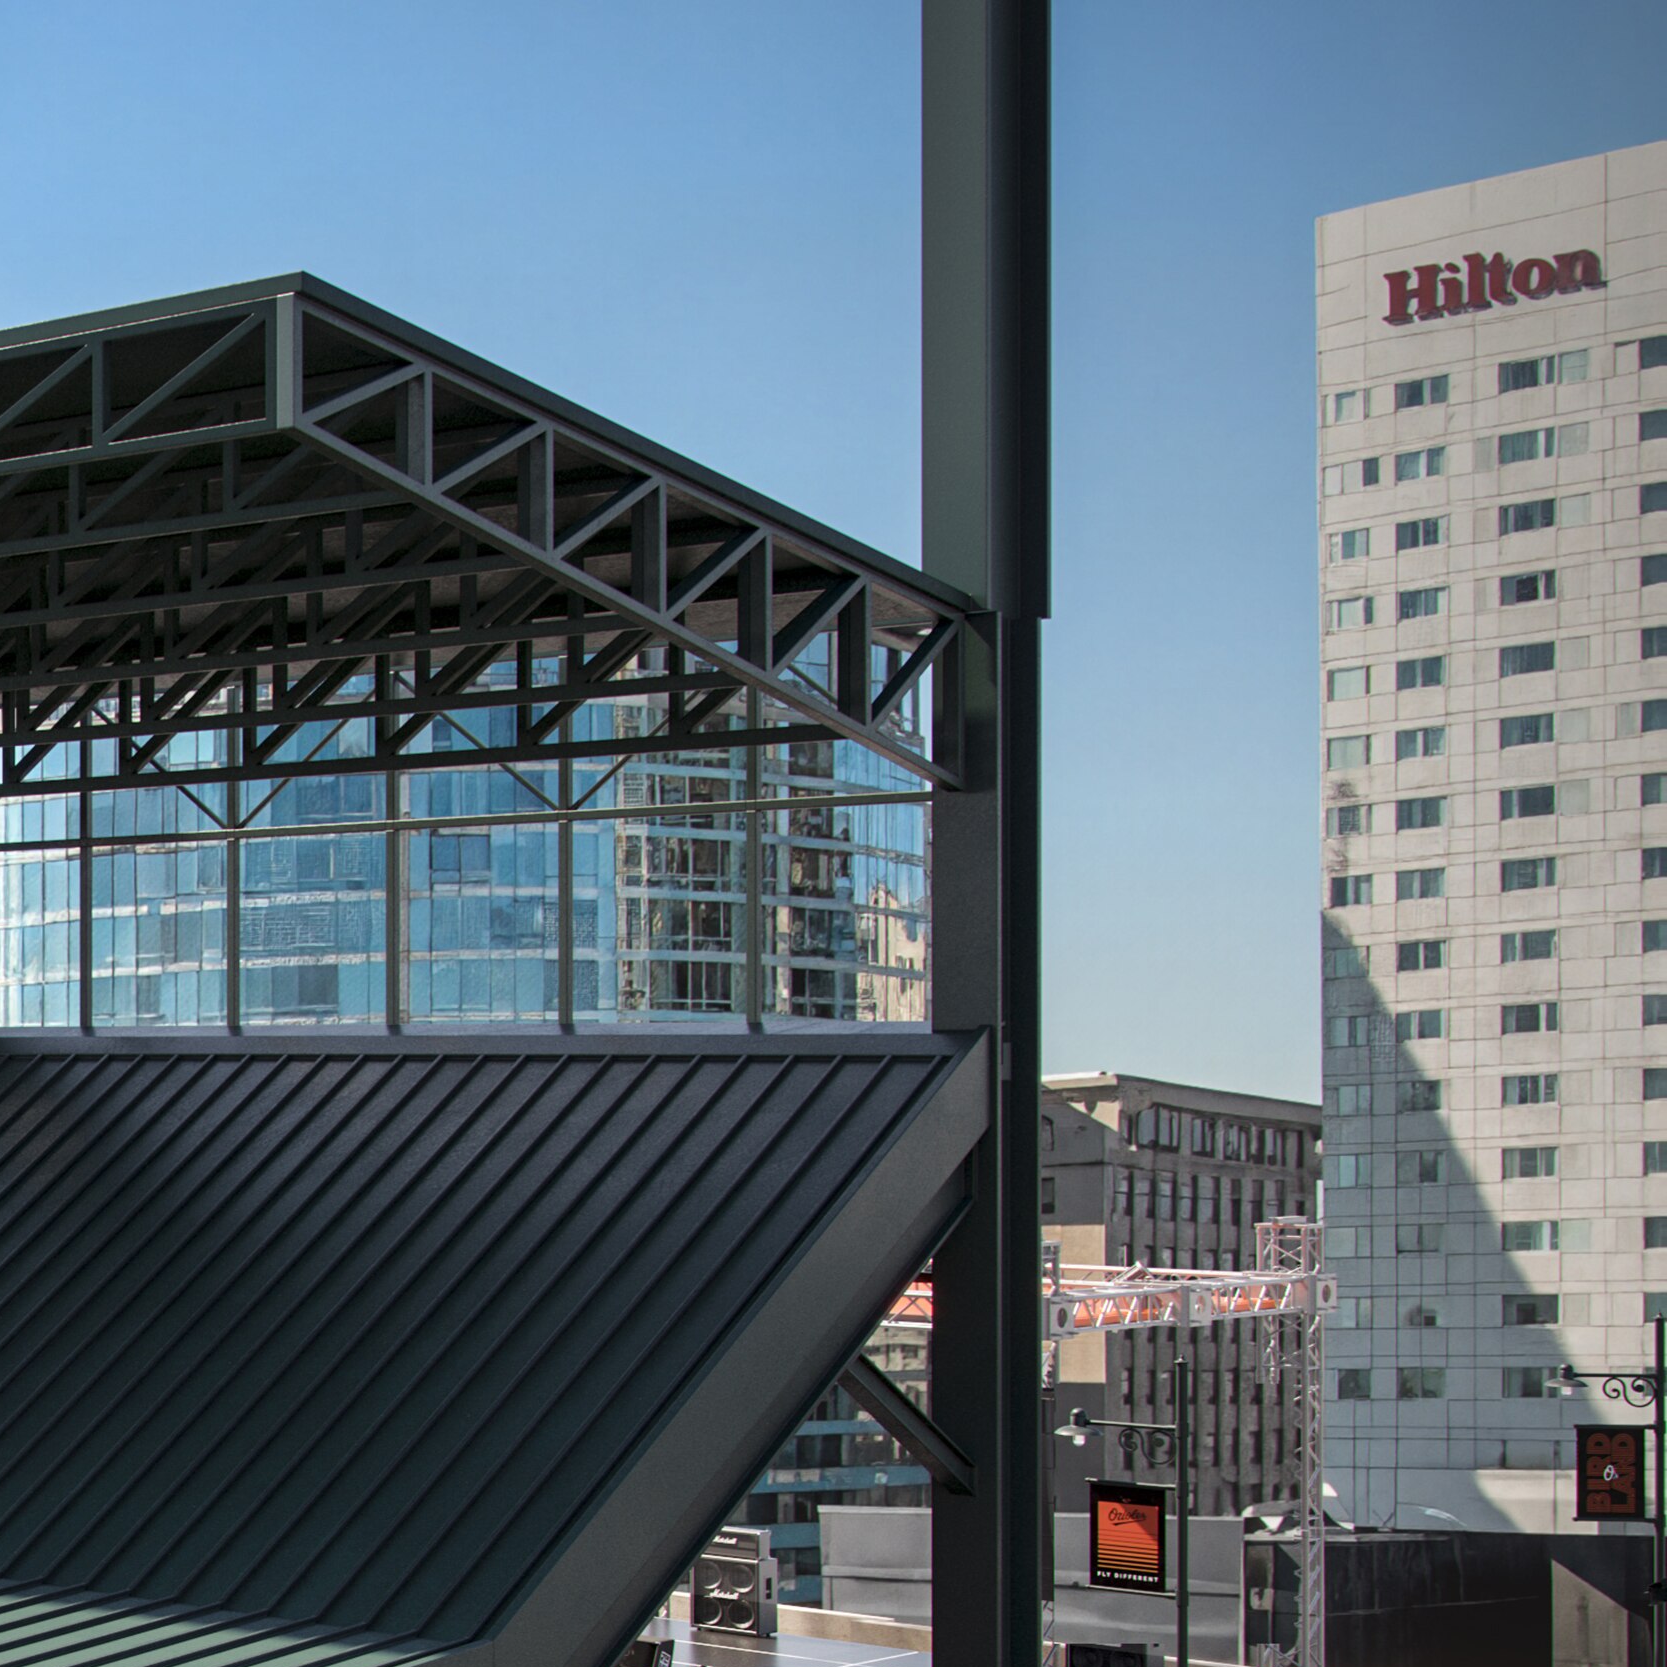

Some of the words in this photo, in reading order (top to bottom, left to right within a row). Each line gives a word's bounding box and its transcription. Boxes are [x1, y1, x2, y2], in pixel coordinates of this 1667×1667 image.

[1382, 249, 1607, 325] Hilton
[1108, 1507, 1147, 1522] Orioles
[1097, 1570, 1112, 1578] FLY
[1114, 1573, 1159, 1583] DIFFERENT
